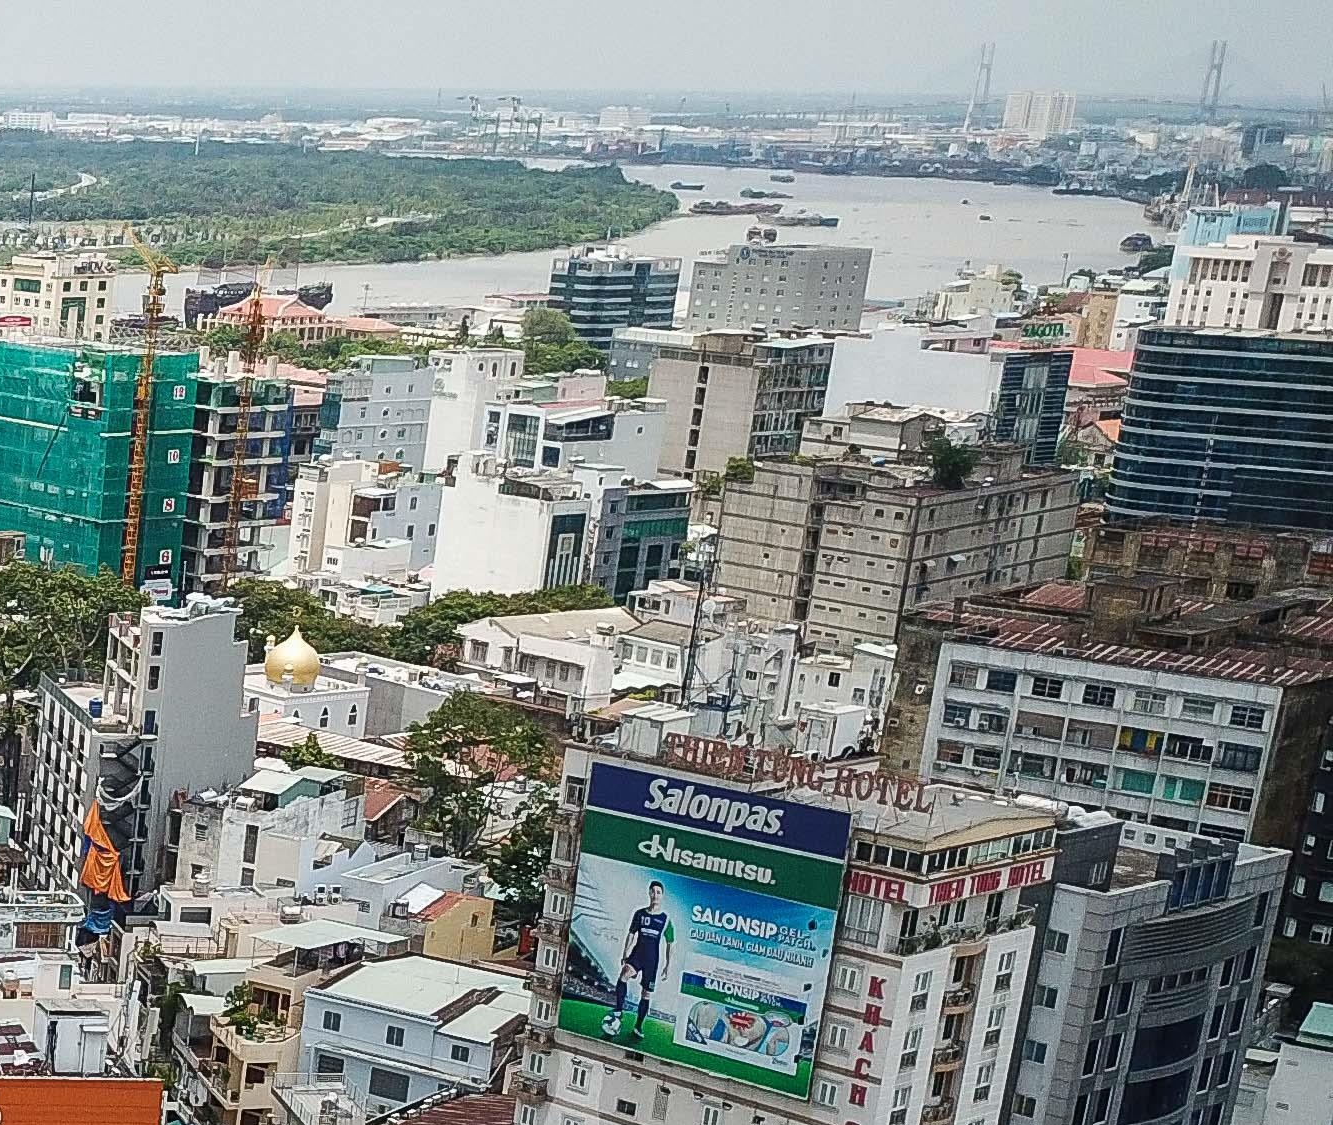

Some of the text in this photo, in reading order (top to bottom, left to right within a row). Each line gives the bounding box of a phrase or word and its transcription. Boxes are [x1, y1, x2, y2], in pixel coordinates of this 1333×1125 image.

[161, 551, 170, 563] 6
[833, 767, 934, 814] HOTEL
[1007, 861, 1046, 887] HOTEL
[641, 915, 651, 926] 10
[692, 905, 778, 940] SALONSIP
[704, 978, 760, 1000] SALONSIP
[848, 975, 887, 1107] KHÁCH
